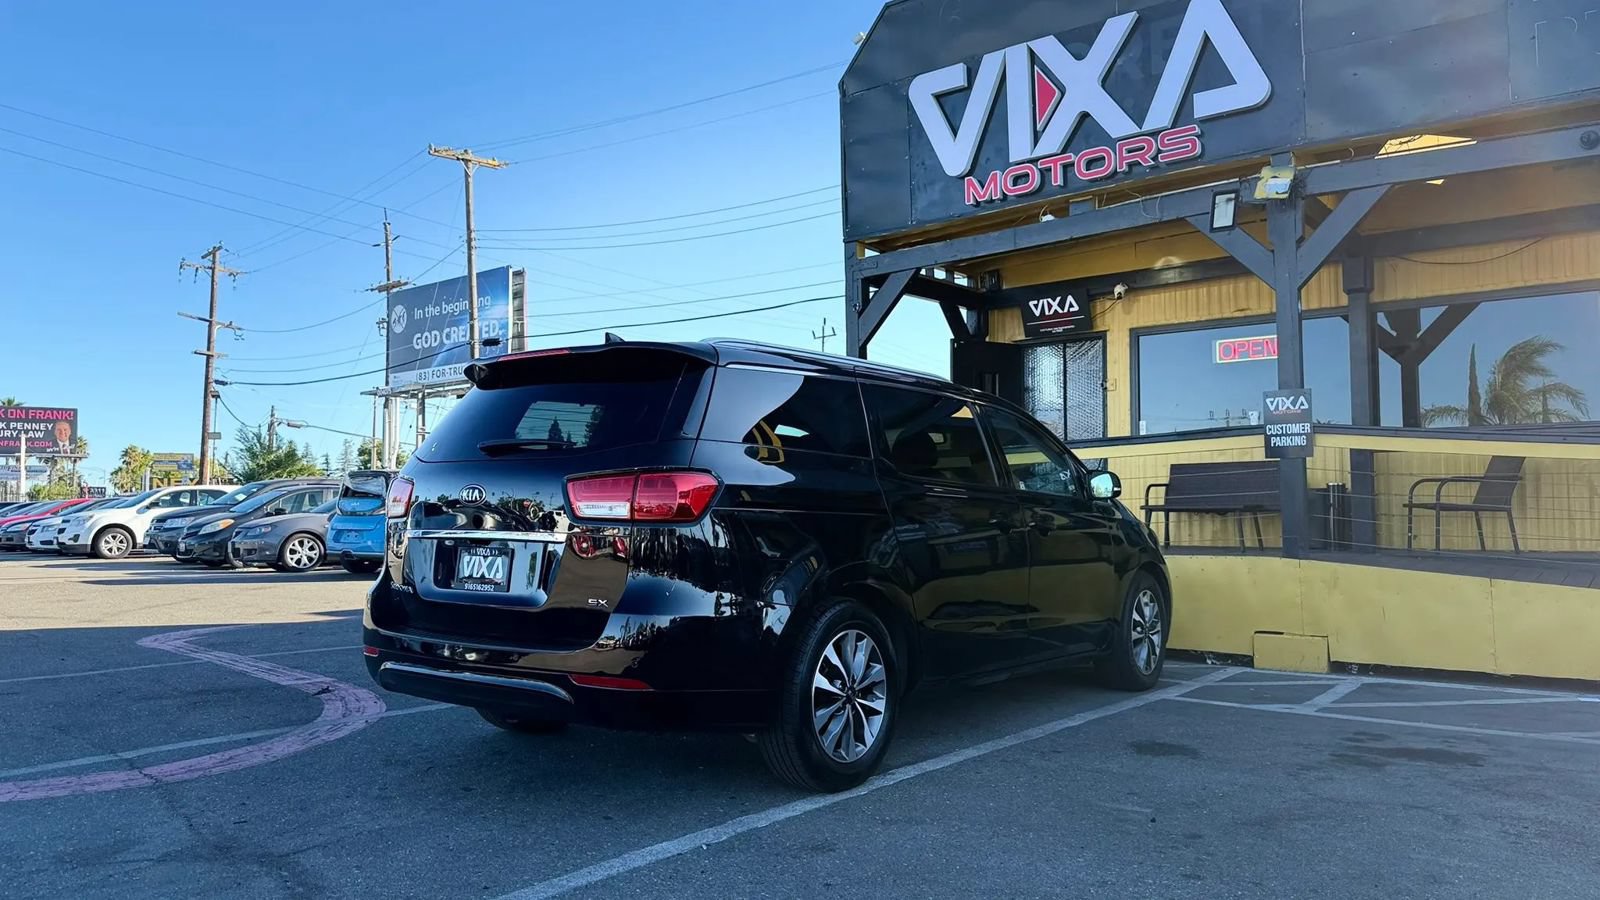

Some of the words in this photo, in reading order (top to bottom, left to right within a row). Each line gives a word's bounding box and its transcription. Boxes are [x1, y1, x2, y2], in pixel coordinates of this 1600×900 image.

[908, 0, 1272, 177] VIXA
[964, 124, 1203, 207] MOTORS
[414, 307, 423, 320] In
[425, 304, 440, 318] the
[442, 296, 491, 314] beginng
[1028, 294, 1080, 317] VIXA
[413, 330, 440, 350] GOD
[442, 319, 503, 344] CREED.
[1219, 338, 1279, 360] OPEN
[1265, 395, 1309, 412] VIXA
[8, 409, 26, 419] ON
[29, 410, 74, 420] FRANK!
[10, 422, 54, 431] PENNEY
[1266, 422, 1311, 435] CUSTOMER
[0, 440, 53, 448] NFRAK.COM
[1270, 435, 1307, 447] PARKING
[461, 488, 481, 501] KIA
[463, 554, 504, 579] VIXA
[587, 598, 609, 608] EX
